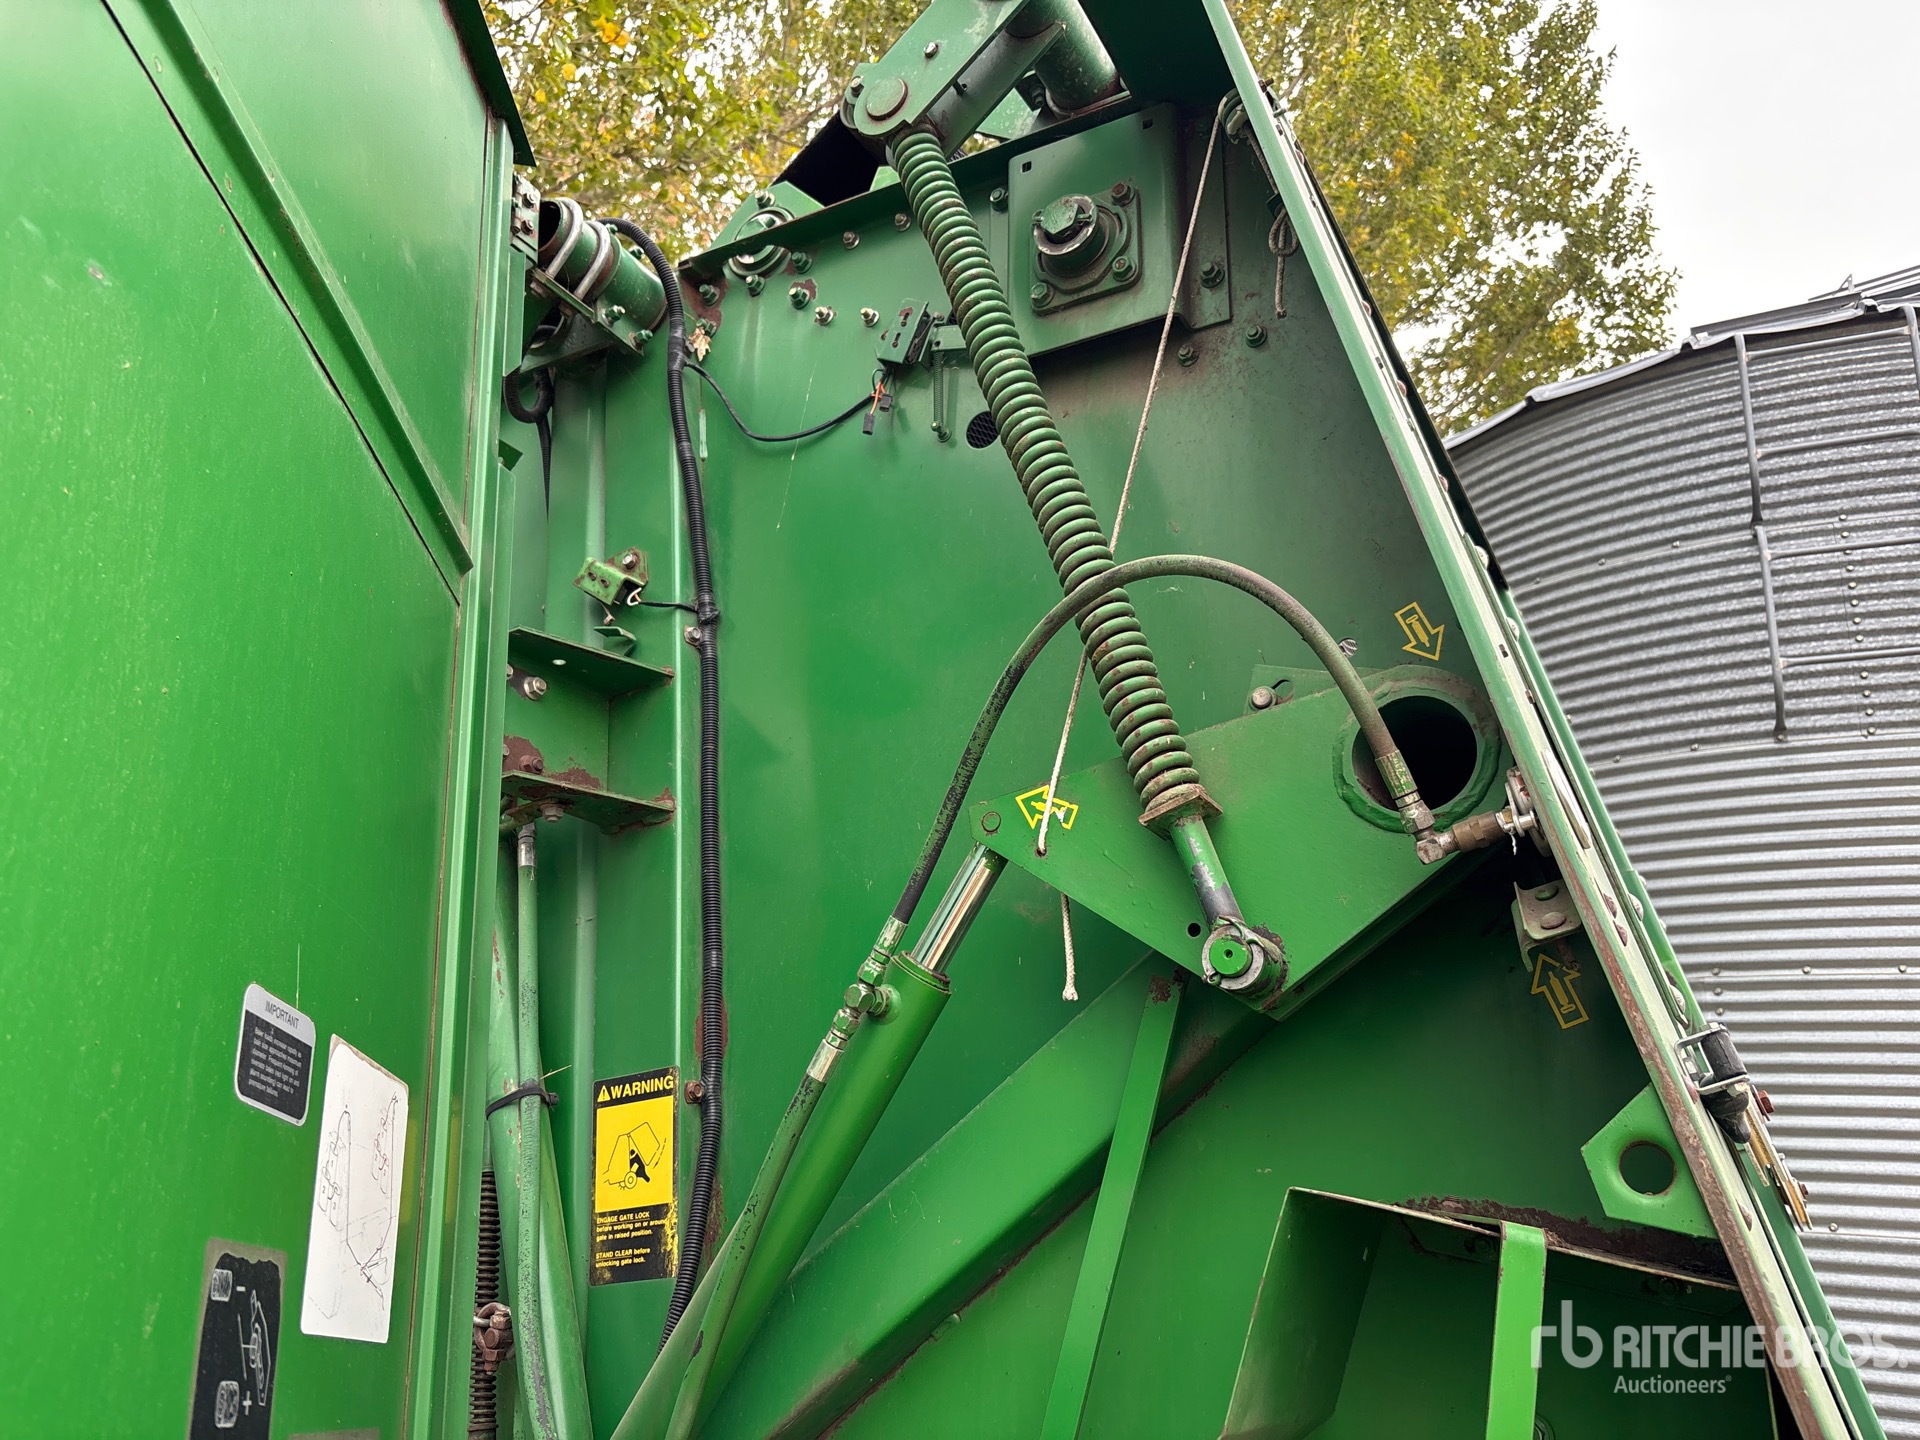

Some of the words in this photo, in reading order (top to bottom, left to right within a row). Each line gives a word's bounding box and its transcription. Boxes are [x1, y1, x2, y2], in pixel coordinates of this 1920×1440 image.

[265, 1000, 299, 1029] IMPORTANT
[611, 1075, 673, 1099] WARNING
[597, 1215, 618, 1224] ENGAGE
[619, 1213, 634, 1221] GATE
[635, 1211, 650, 1219] LOCK
[631, 1229, 653, 1238] position.
[595, 1251, 614, 1259] STAND
[633, 1247, 651, 1255] before
[595, 1260, 619, 1268] unlocking
[621, 1258, 632, 1266] gate
